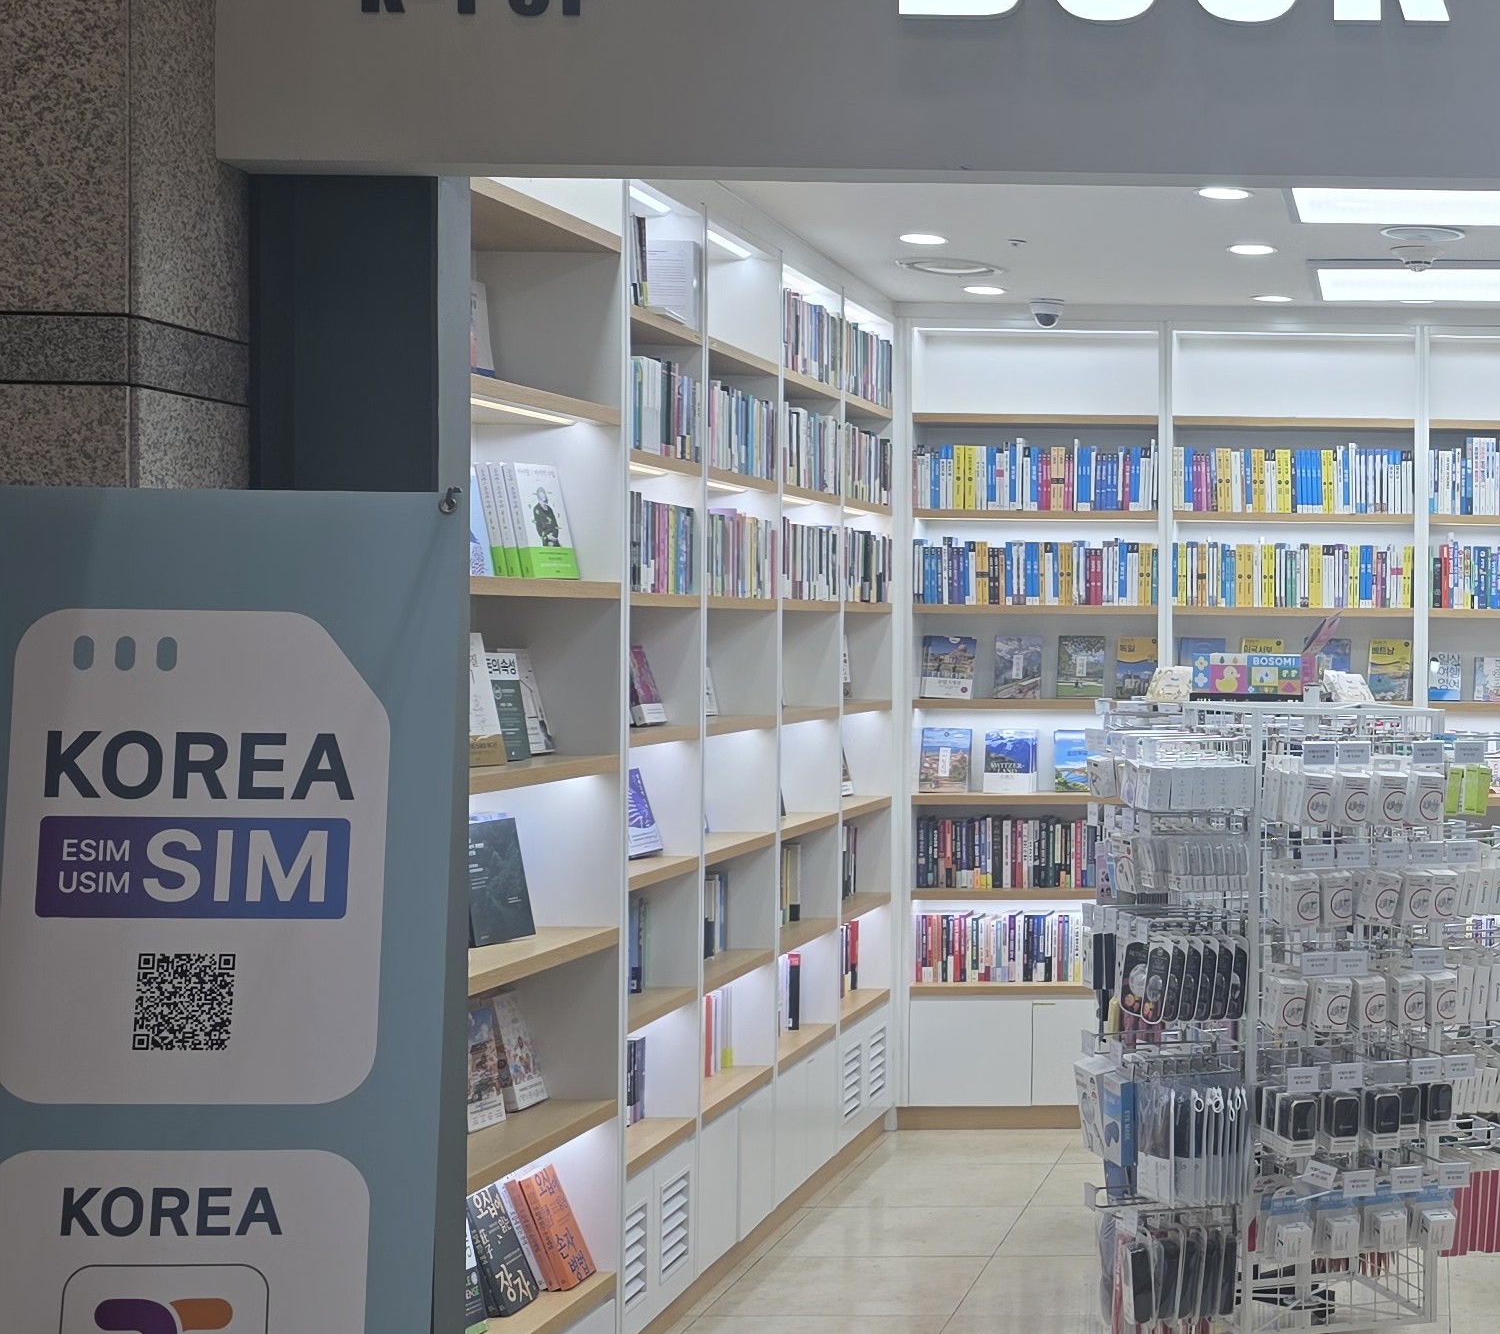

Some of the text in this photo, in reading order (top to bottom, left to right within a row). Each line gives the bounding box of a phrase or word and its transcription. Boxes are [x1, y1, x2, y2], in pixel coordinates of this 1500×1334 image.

[500, 658, 517, 674] 속성
[1252, 657, 1296, 666] BOSOMI
[44, 730, 354, 800] KOREA
[63, 839, 130, 861] ESIM
[143, 829, 328, 902] SIM
[59, 871, 129, 893] USIM
[60, 1187, 282, 1237] KOREA
[495, 1264, 533, 1303] 장자
